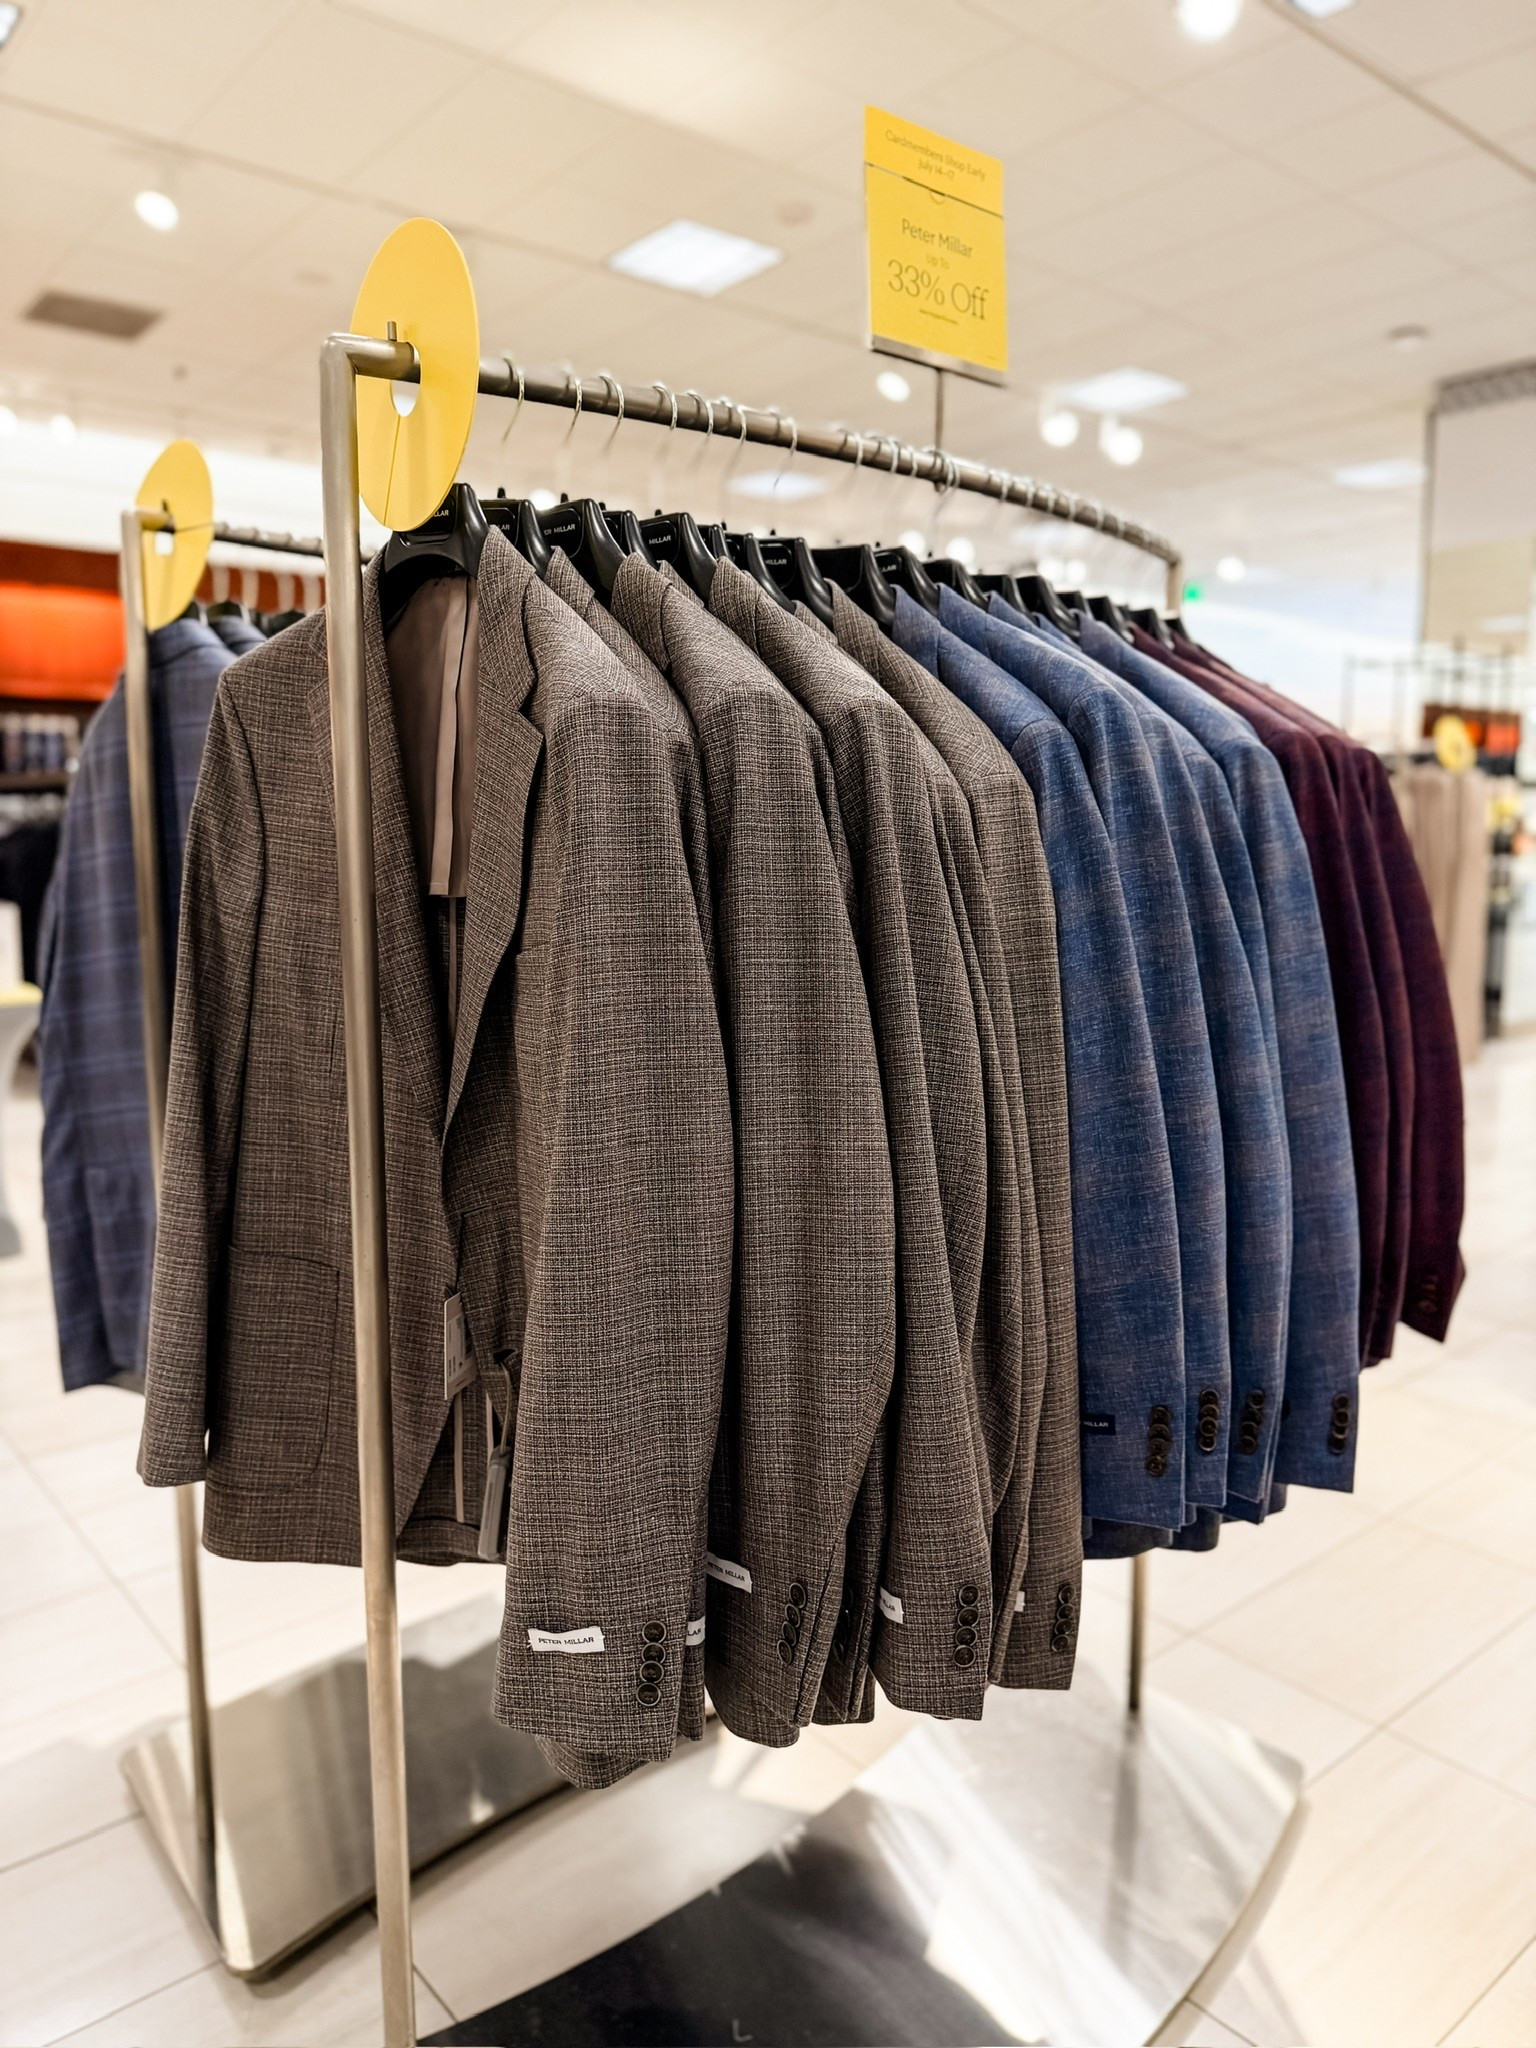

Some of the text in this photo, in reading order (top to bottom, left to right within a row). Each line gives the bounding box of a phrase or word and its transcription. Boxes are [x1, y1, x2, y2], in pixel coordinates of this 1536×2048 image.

[884, 129, 987, 181] Cardmembers Shop Early
[917, 158, 933, 175] July
[901, 217, 973, 258] Peter Millar
[887, 259, 946, 307] 33%
[950, 281, 991, 321] Off
[552, 523, 577, 534] MILLAR
[648, 535, 672, 545] MILLAR
[724, 1569, 747, 1583] MILLAR
[538, 1636, 595, 1646] PETER MILLAR
